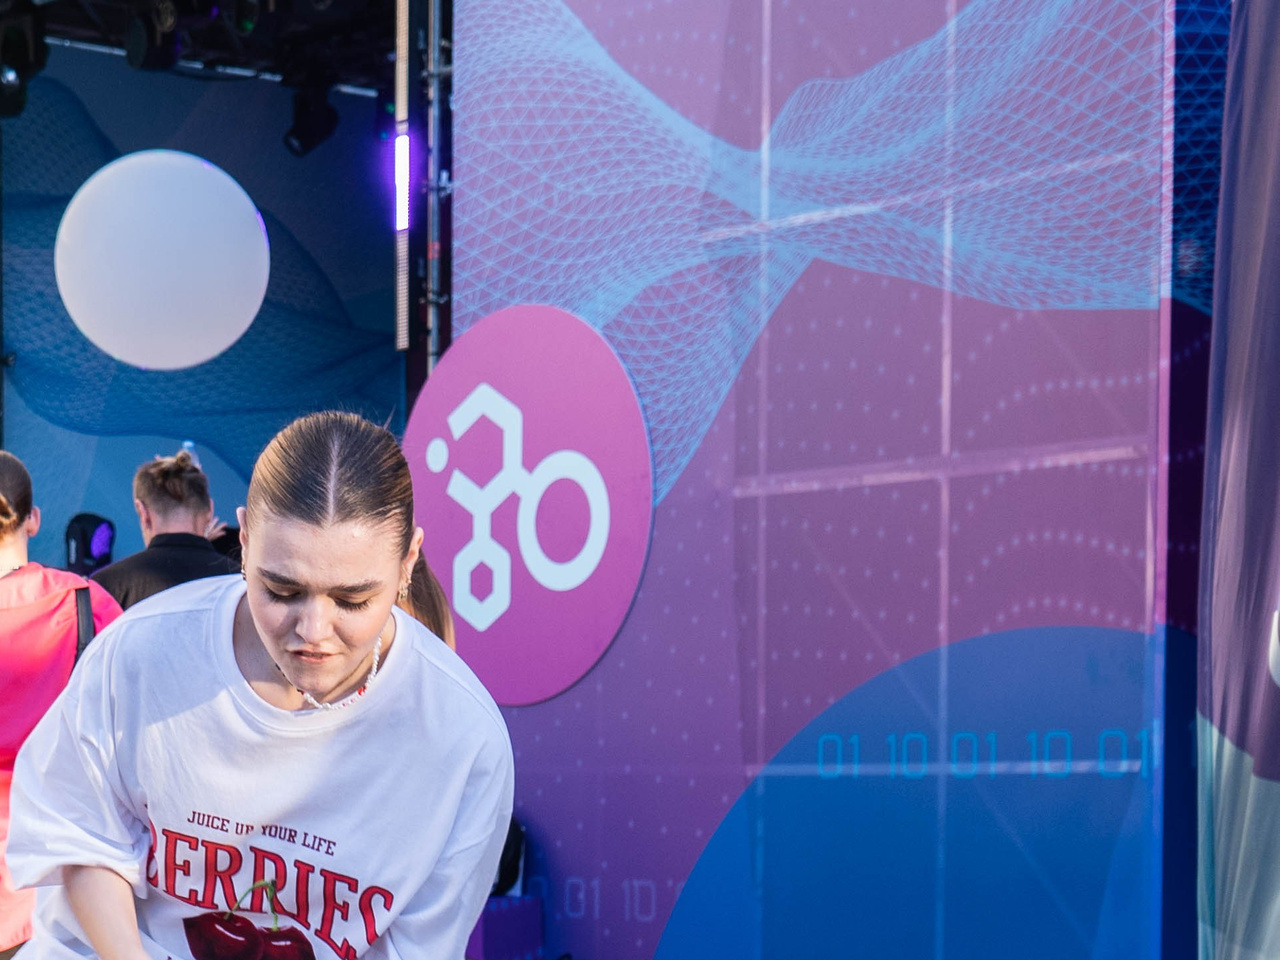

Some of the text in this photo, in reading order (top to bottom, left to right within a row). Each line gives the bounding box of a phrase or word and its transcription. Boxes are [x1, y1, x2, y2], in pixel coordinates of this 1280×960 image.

[817, 731, 861, 780] 01
[886, 730, 929, 780] 10
[950, 730, 997, 780] 01
[1026, 728, 1073, 780] 10
[187, 810, 230, 833] JUICE
[260, 824, 298, 844] YOUR
[301, 831, 337, 857] LIFE
[564, 876, 600, 920] 01
[621, 878, 656, 922] 10
